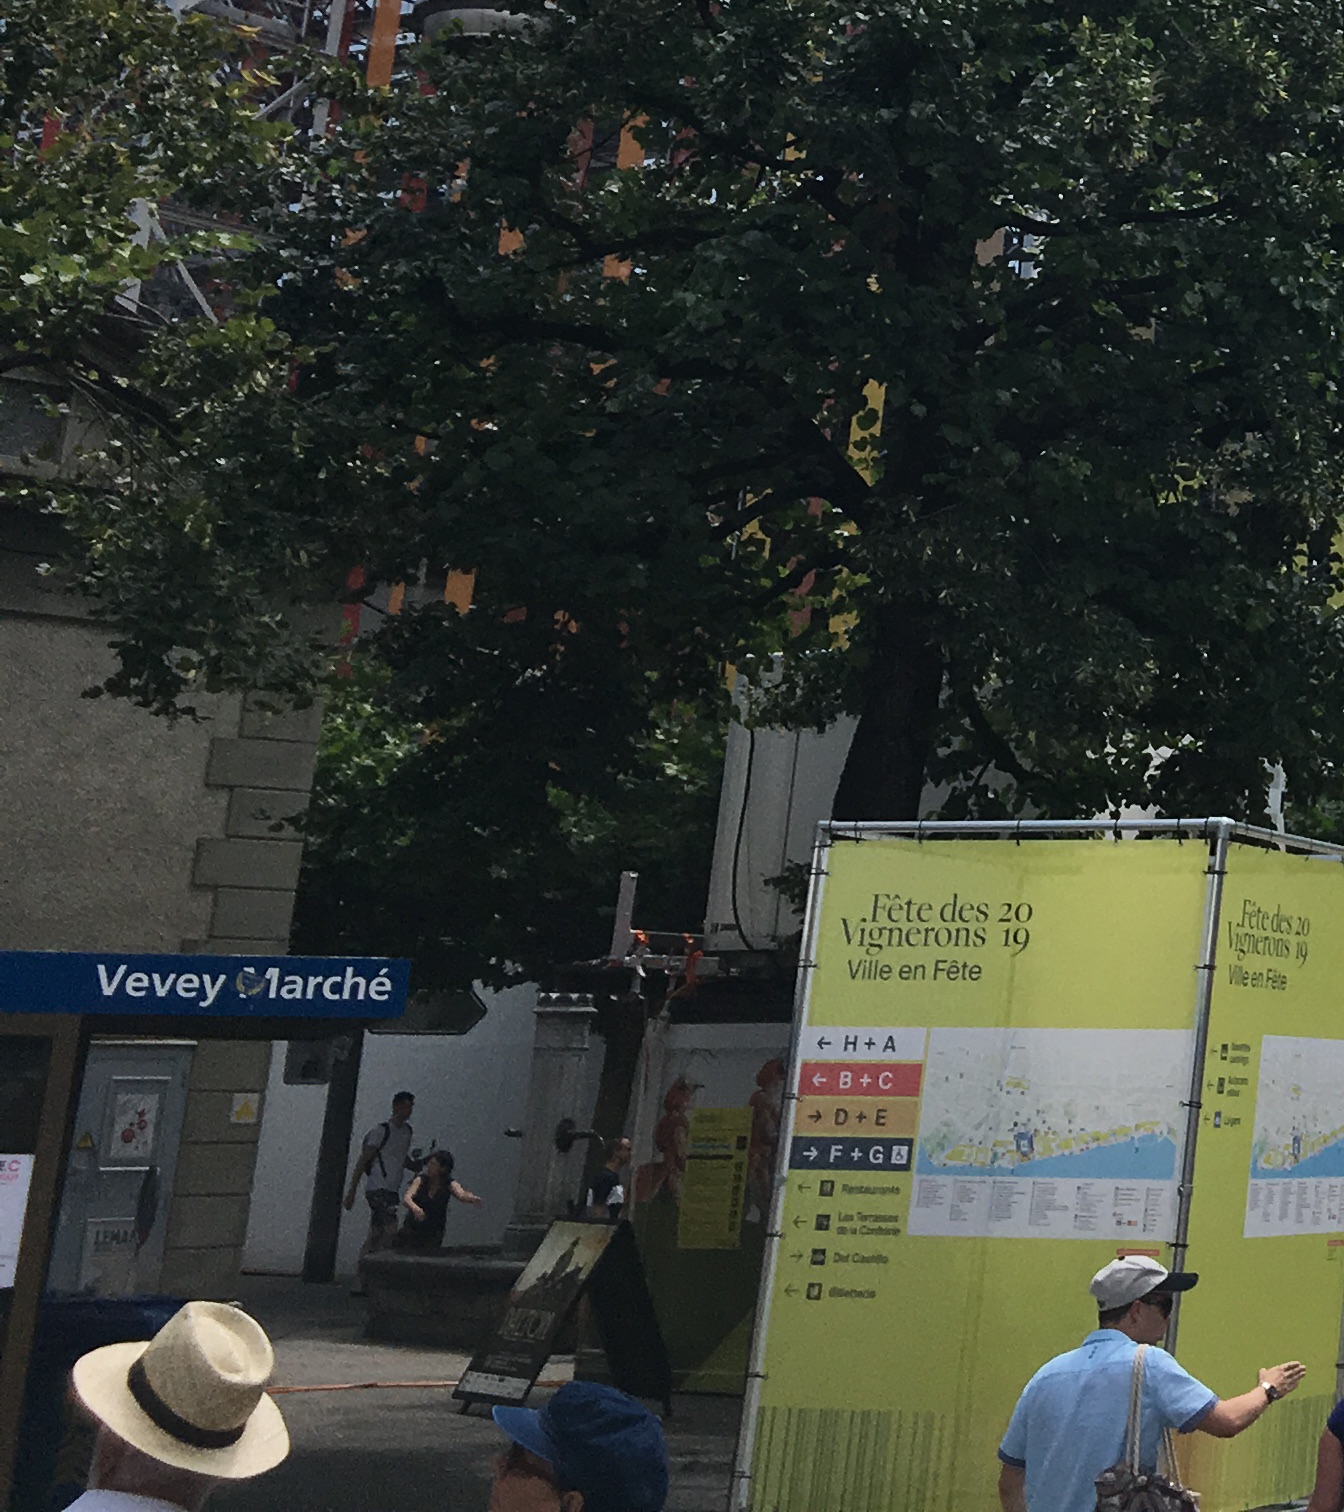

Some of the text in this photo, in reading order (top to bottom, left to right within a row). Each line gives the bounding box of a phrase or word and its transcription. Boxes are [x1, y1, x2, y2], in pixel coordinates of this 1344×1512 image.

[870, 893, 1033, 924] Fête des 20
[1236, 899, 1310, 937] Fête des 20
[841, 917, 1030, 958] Vignerons 19
[1228, 921, 1308, 969] Vignerons 19
[847, 959, 982, 982] Ville en Fête
[1228, 964, 1287, 991] Ville en Fête
[97, 964, 393, 1007] Vevey Marché
[843, 1035, 858, 1052] H
[882, 1035, 896, 1052] A
[839, 1071, 852, 1089] B
[878, 1071, 893, 1090] C
[834, 1108, 848, 1126] D
[875, 1108, 888, 1126] E
[829, 1145, 843, 1163] F
[869, 1145, 884, 1164] G
